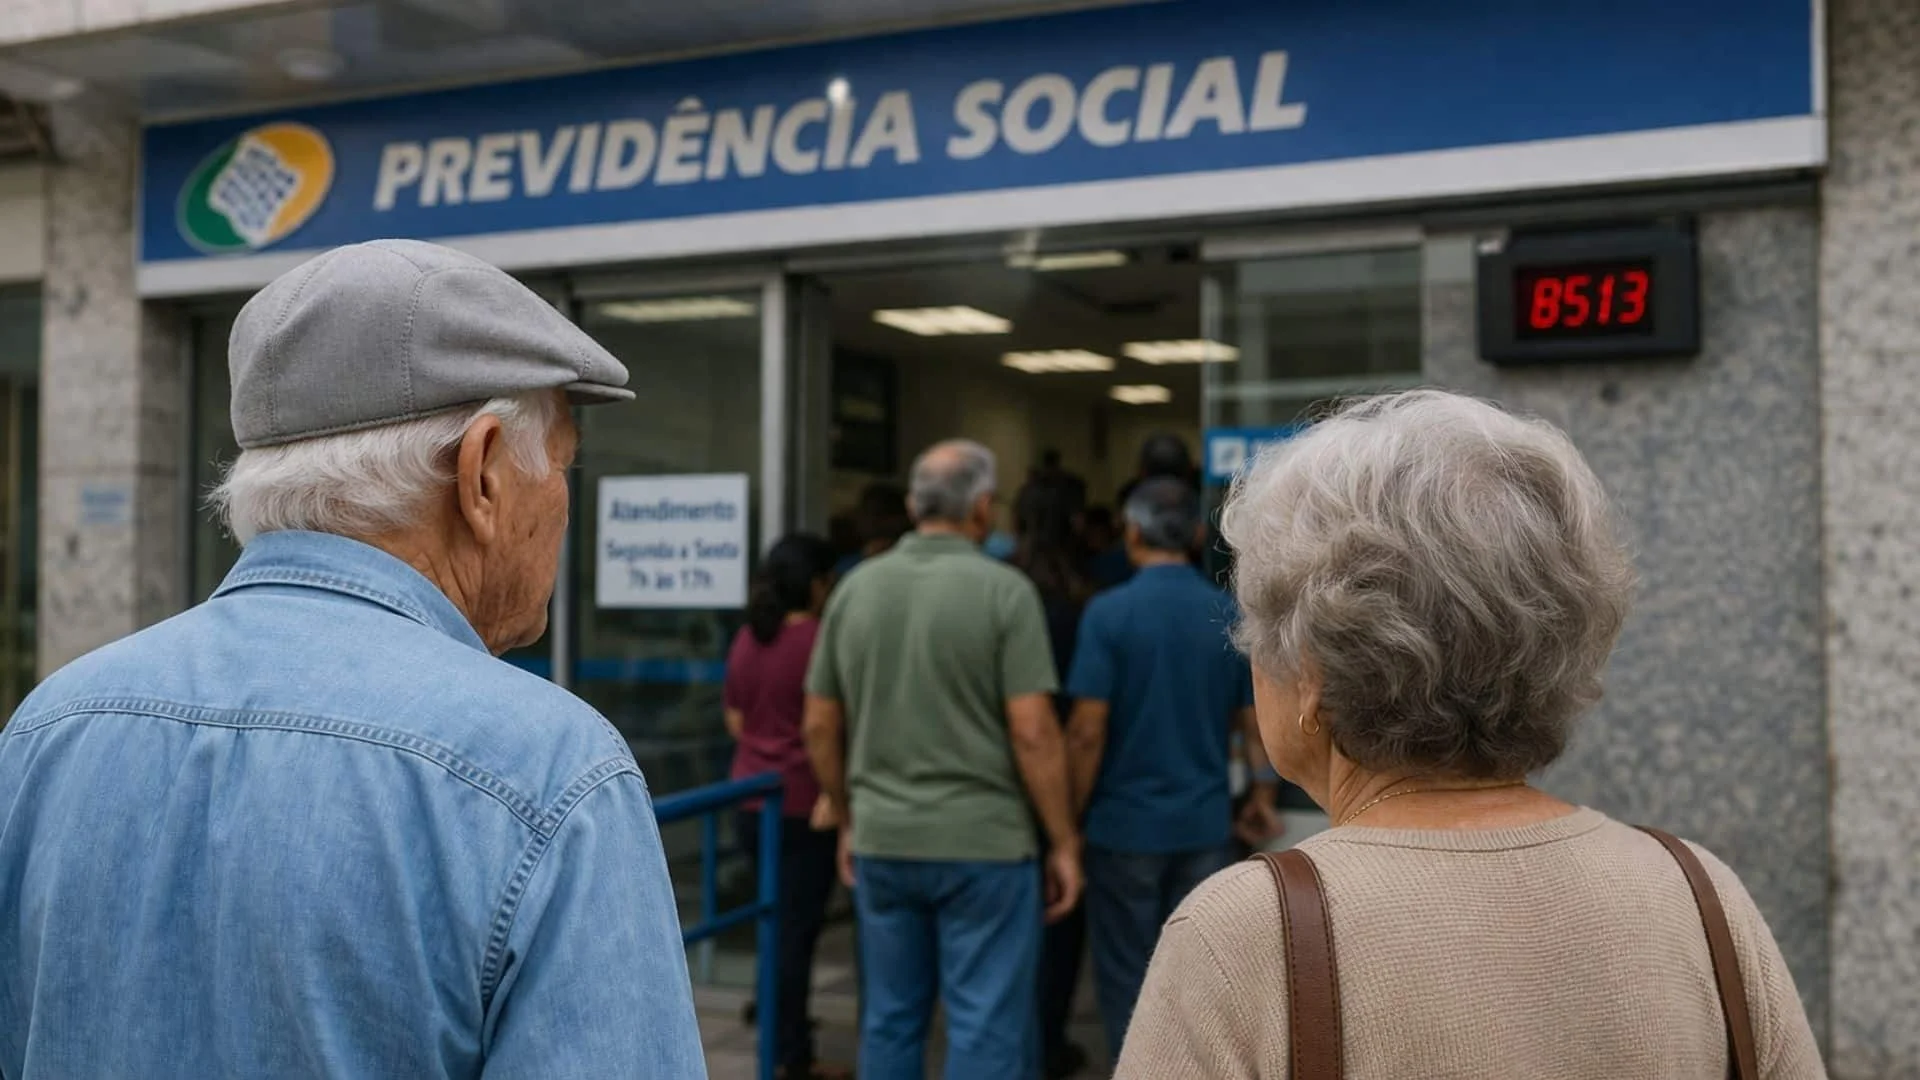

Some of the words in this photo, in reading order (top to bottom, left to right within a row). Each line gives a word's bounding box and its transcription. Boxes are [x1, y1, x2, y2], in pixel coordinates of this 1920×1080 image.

[373, 92, 920, 211] PREVIDÊNCIA
[946, 51, 1307, 160] SOCIAL
[609, 498, 738, 520] Atendimento
